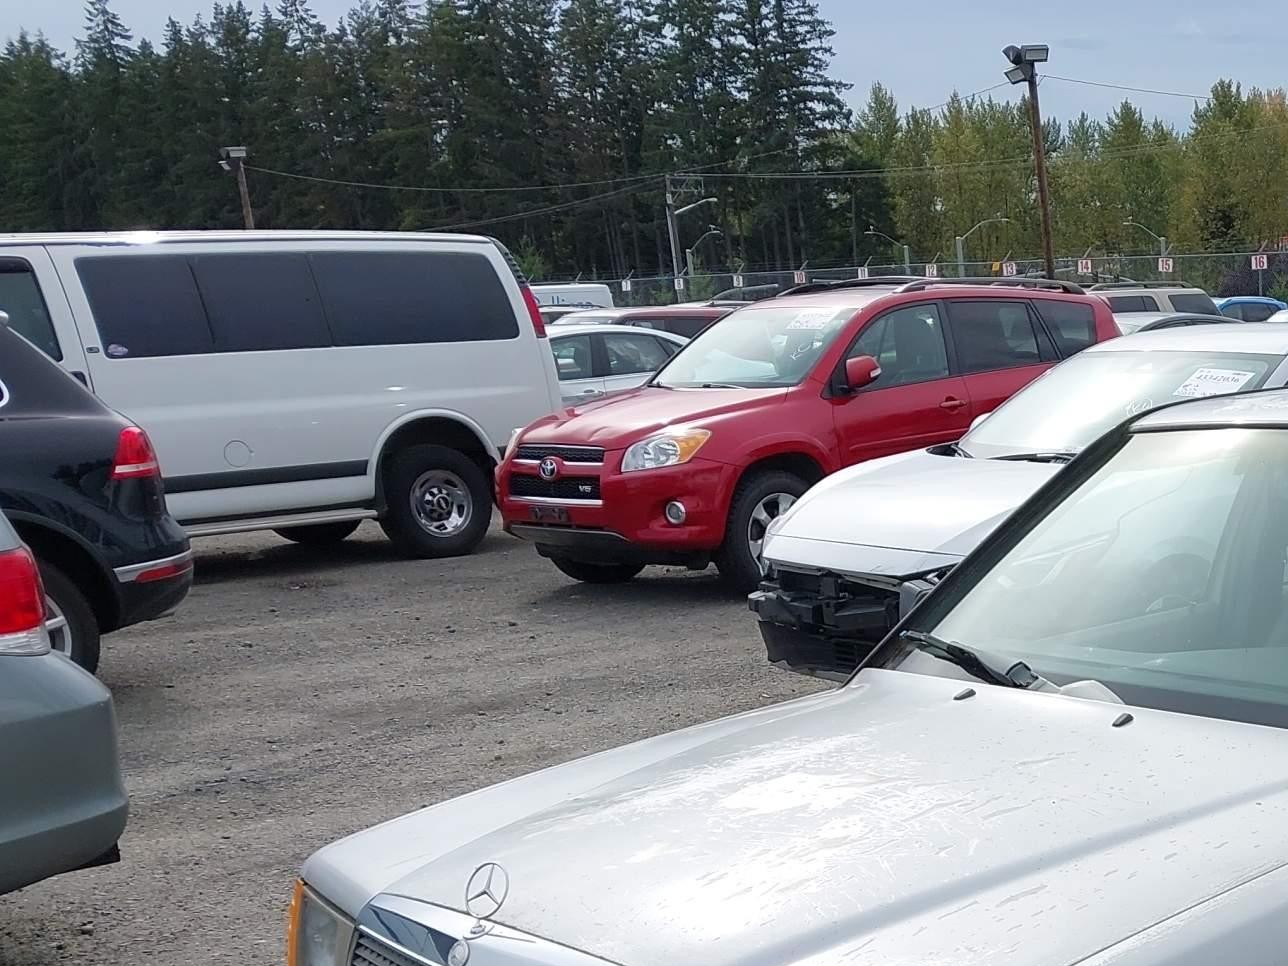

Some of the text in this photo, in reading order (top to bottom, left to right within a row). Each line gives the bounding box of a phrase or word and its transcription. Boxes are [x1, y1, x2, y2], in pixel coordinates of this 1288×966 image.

[1004, 262, 1014, 275] 13
[1079, 259, 1091, 272] 14
[1159, 258, 1171, 271] 15
[1253, 255, 1265, 269] 16
[927, 264, 936, 276] 12
[795, 271, 804, 283] 10
[578, 485, 592, 493] V6
